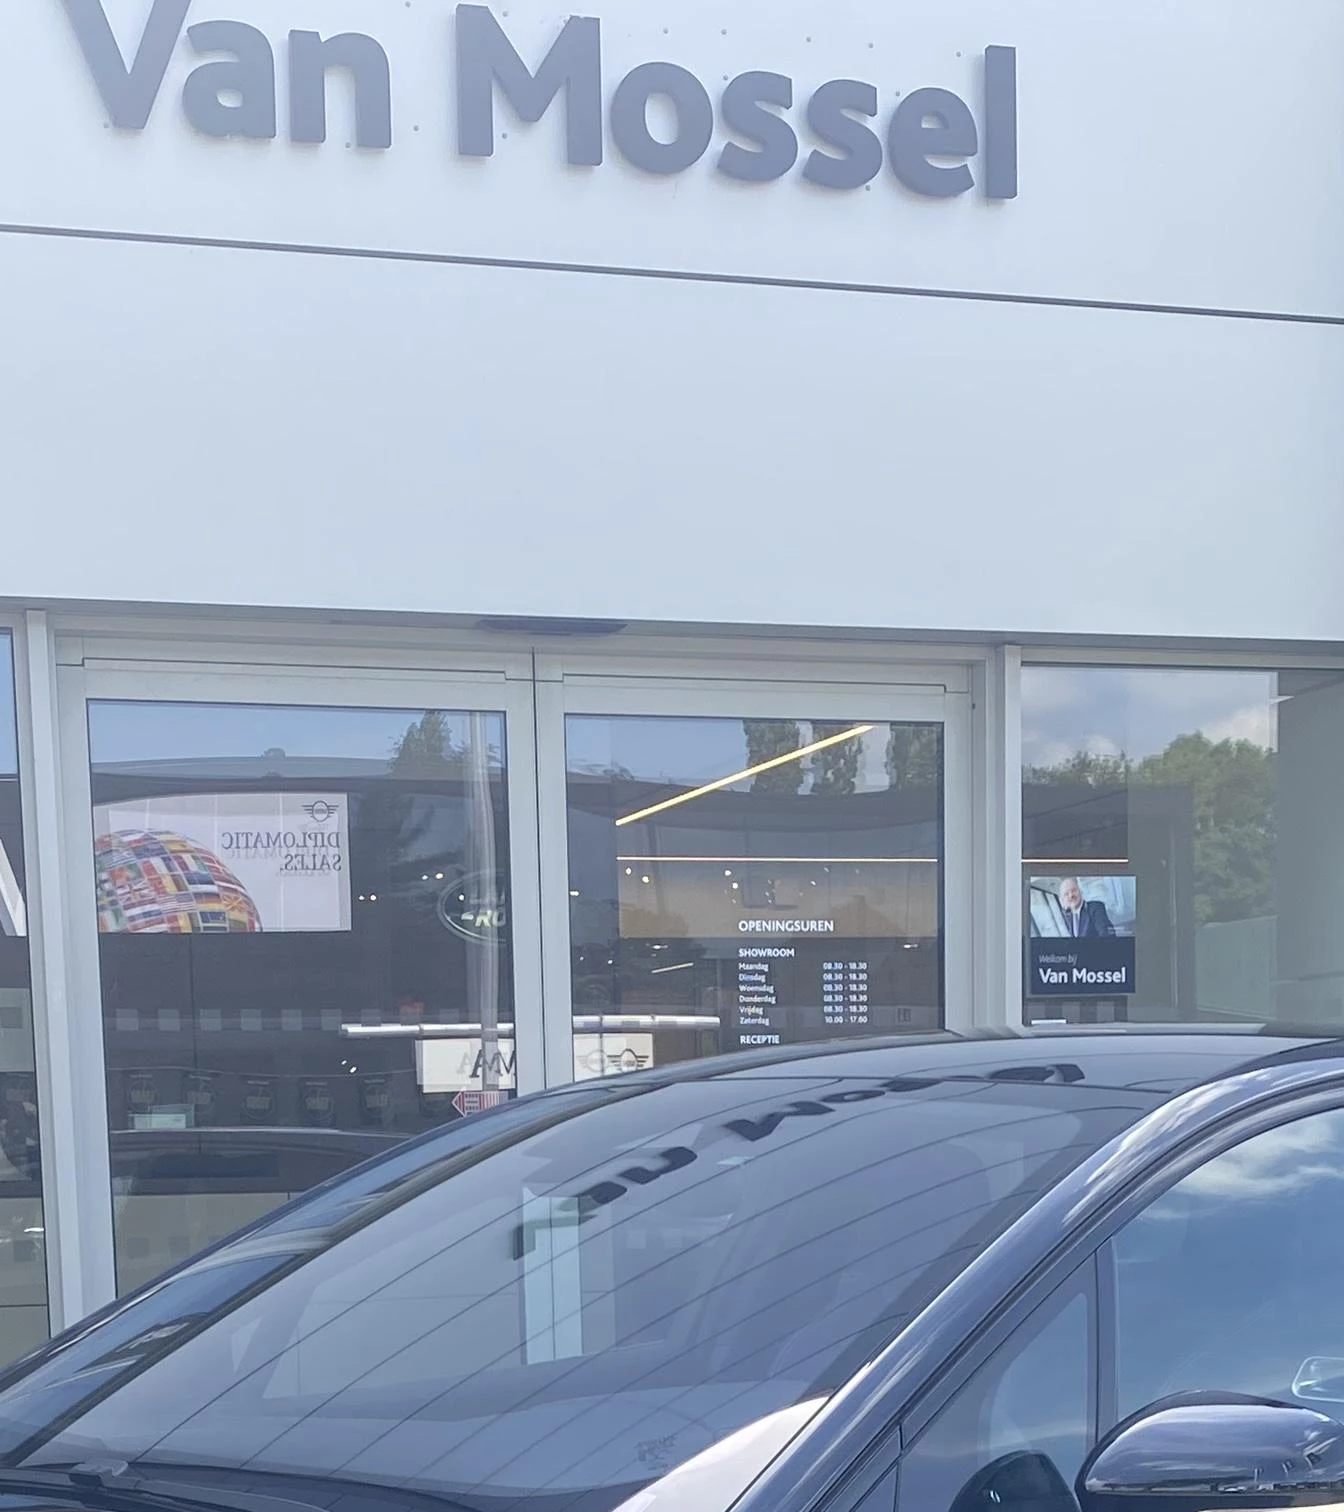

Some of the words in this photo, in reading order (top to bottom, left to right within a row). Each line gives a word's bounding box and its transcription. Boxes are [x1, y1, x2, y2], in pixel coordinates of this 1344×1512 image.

[70, 0, 392, 149] Van
[456, 4, 1018, 200] Mossel
[738, 920, 834, 932] OPENINGSUREN
[738, 948, 795, 957] SHOWROOM
[1039, 967, 1068, 983] Van
[1072, 967, 1126, 983] Mossel
[740, 1035, 780, 1044] RECEPTIE
